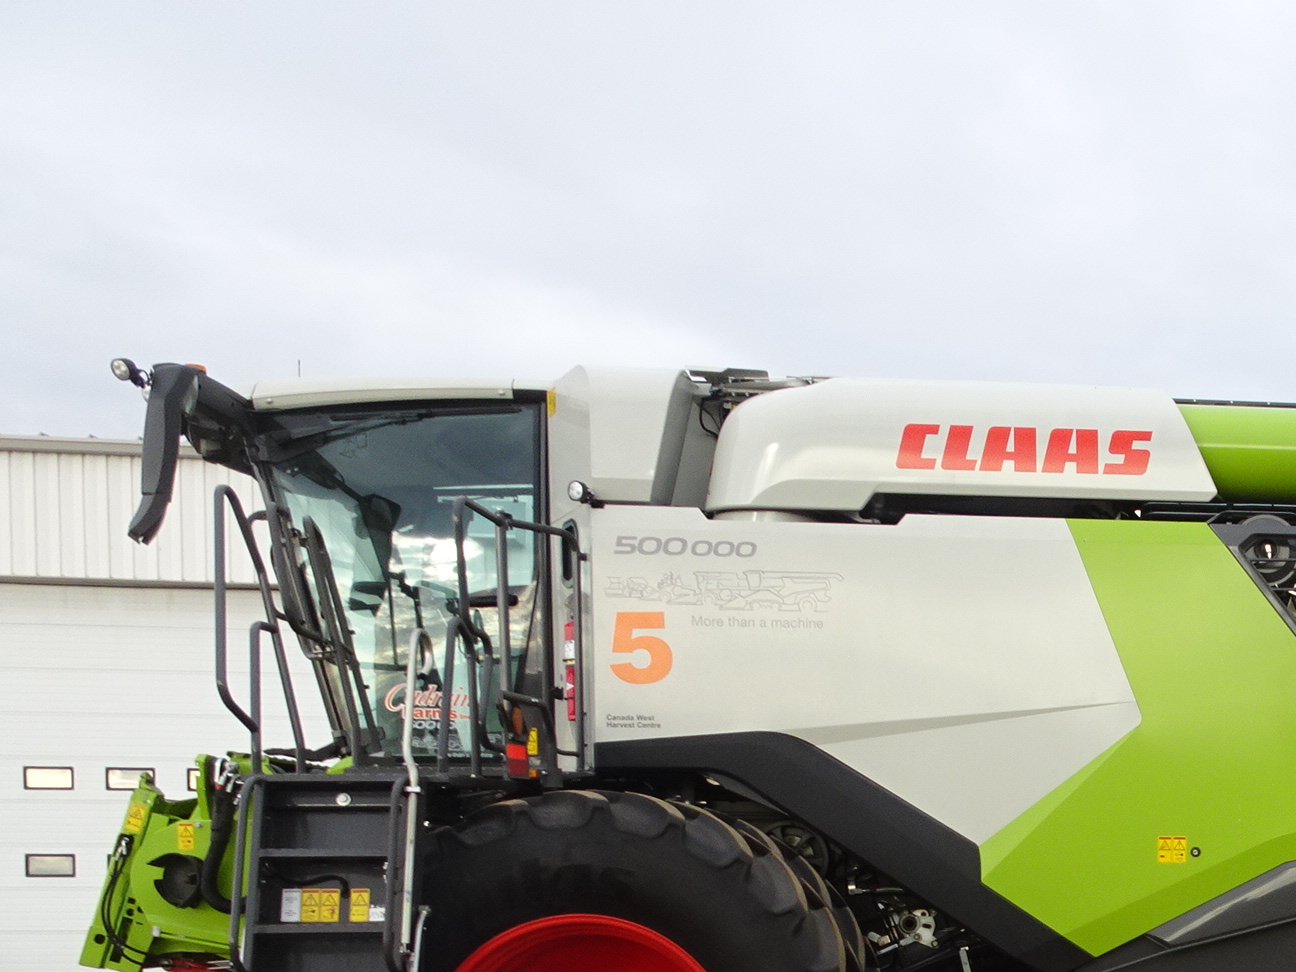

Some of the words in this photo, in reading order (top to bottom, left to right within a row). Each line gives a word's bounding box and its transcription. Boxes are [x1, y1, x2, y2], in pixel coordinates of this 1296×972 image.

[896, 423, 1153, 475] CLAAS
[609, 611, 673, 685] 5
[691, 616, 724, 628] More
[728, 617, 755, 629] than
[759, 619, 767, 628] a
[771, 618, 824, 629] machine
